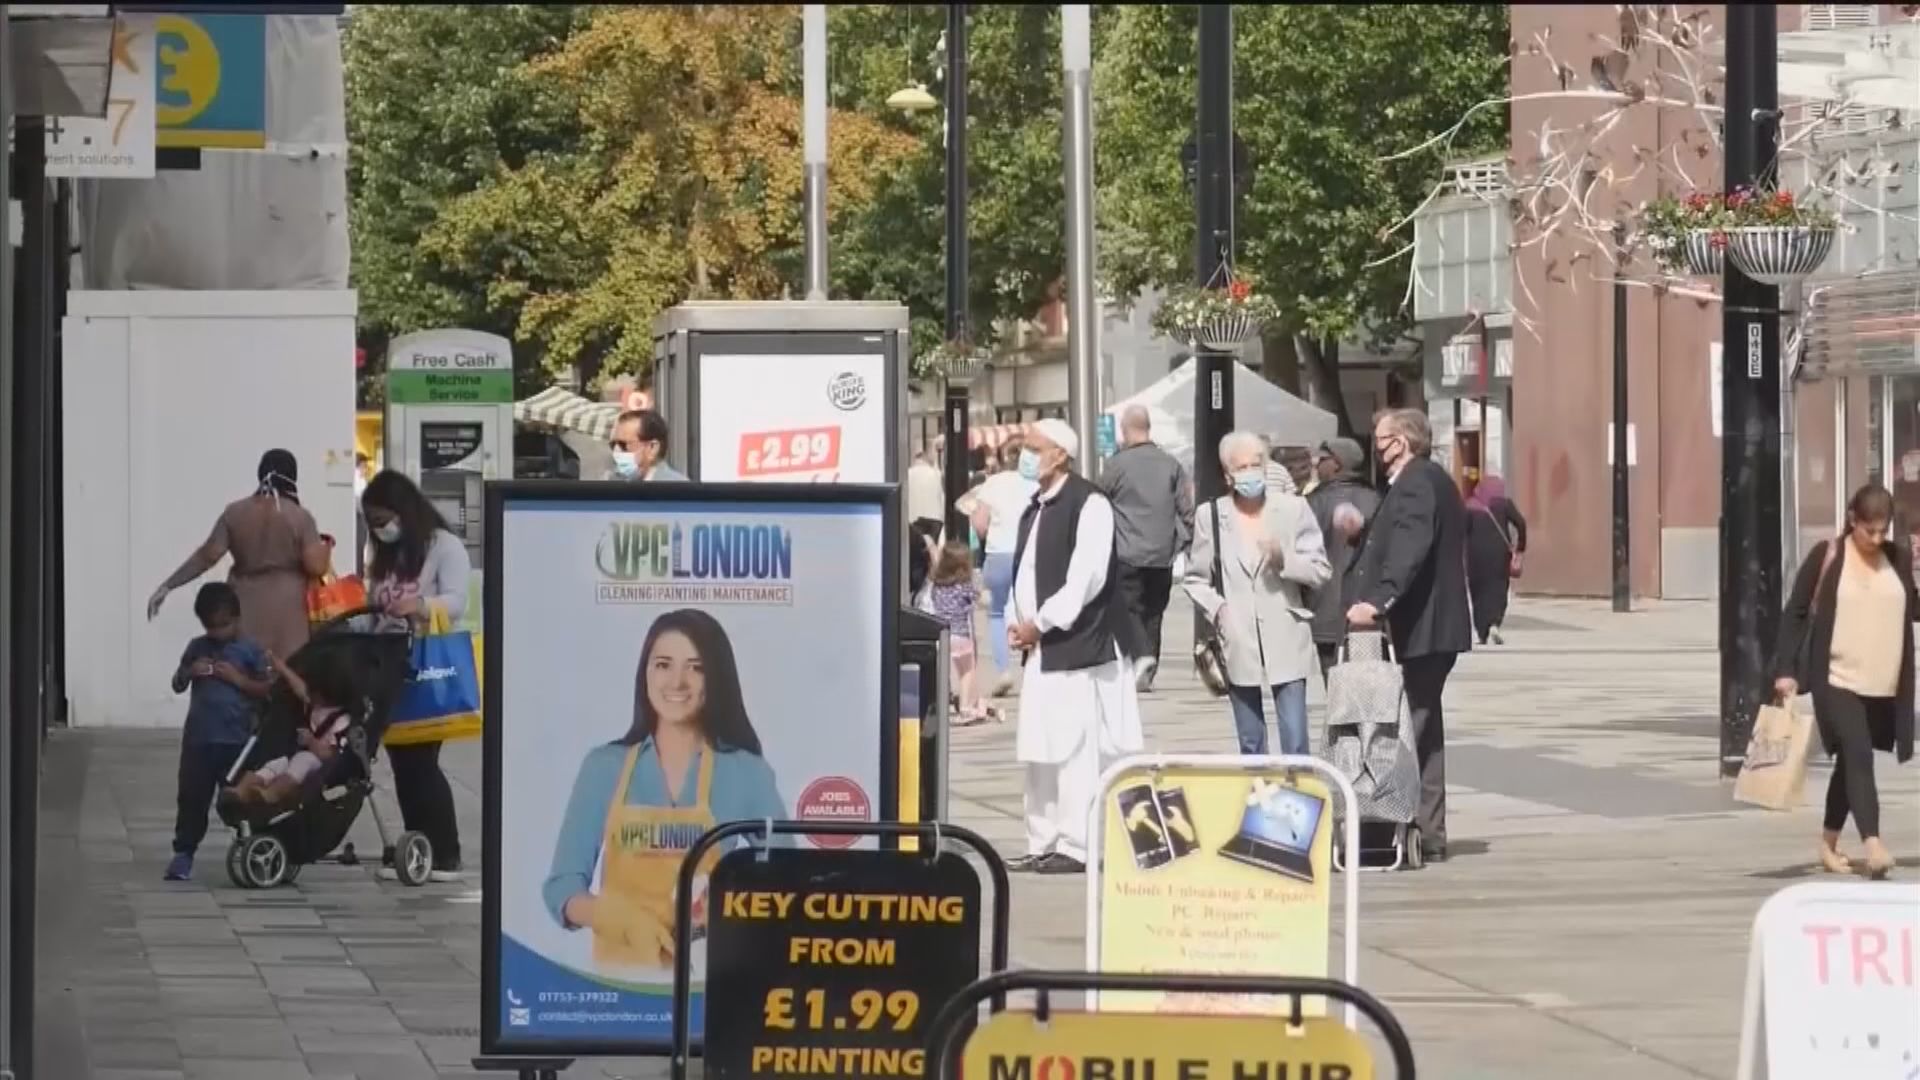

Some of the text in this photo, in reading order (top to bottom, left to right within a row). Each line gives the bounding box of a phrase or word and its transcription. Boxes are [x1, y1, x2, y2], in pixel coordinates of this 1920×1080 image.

[78, 153, 135, 166] solutions
[412, 353, 496, 367] Free Cash
[425, 374, 482, 386] Machine
[429, 388, 480, 400] Service
[832, 385, 866, 403] KING
[745, 432, 831, 471] £2.99
[600, 585, 790, 601] CLEANING PAINTING MAINTENANCE
[819, 791, 851, 802] JOBS
[803, 804, 866, 816] AVAILABLE
[722, 891, 965, 923] KEY CUTTING
[789, 937, 896, 965] FROM
[764, 987, 921, 1031] £1.99
[752, 1046, 926, 1076] PRINTING
